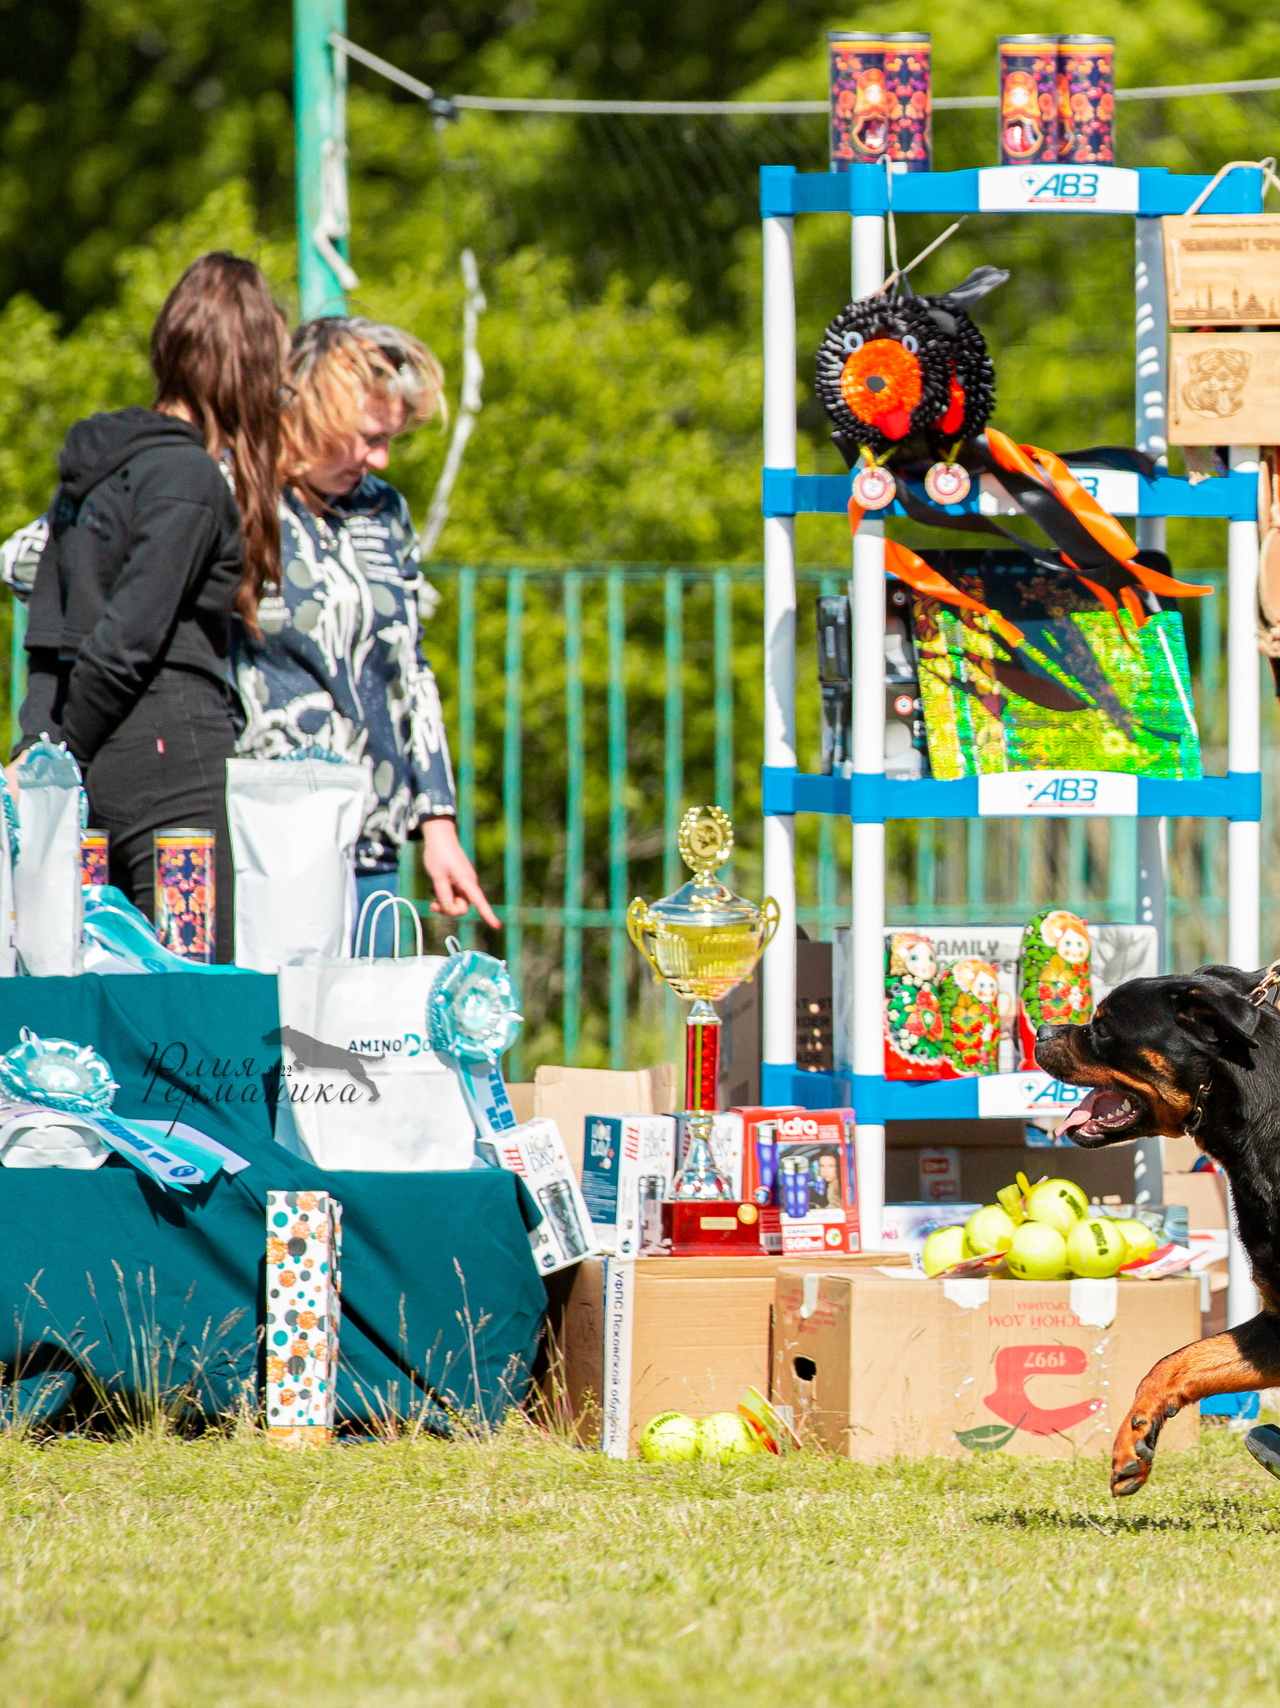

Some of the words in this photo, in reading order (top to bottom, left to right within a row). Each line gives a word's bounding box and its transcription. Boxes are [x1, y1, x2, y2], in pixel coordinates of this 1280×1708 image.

[931, 939, 999, 956] AMILY
[1033, 1079, 1092, 1102] АВ
[613, 1270, 625, 1310] УФПС
[1016, 1302, 1070, 1311] ОРОДИНА
[988, 1314, 1026, 1329] ДОМ
[611, 1313, 624, 1386] Псковской
[1023, 1351, 1068, 1369] 1997
